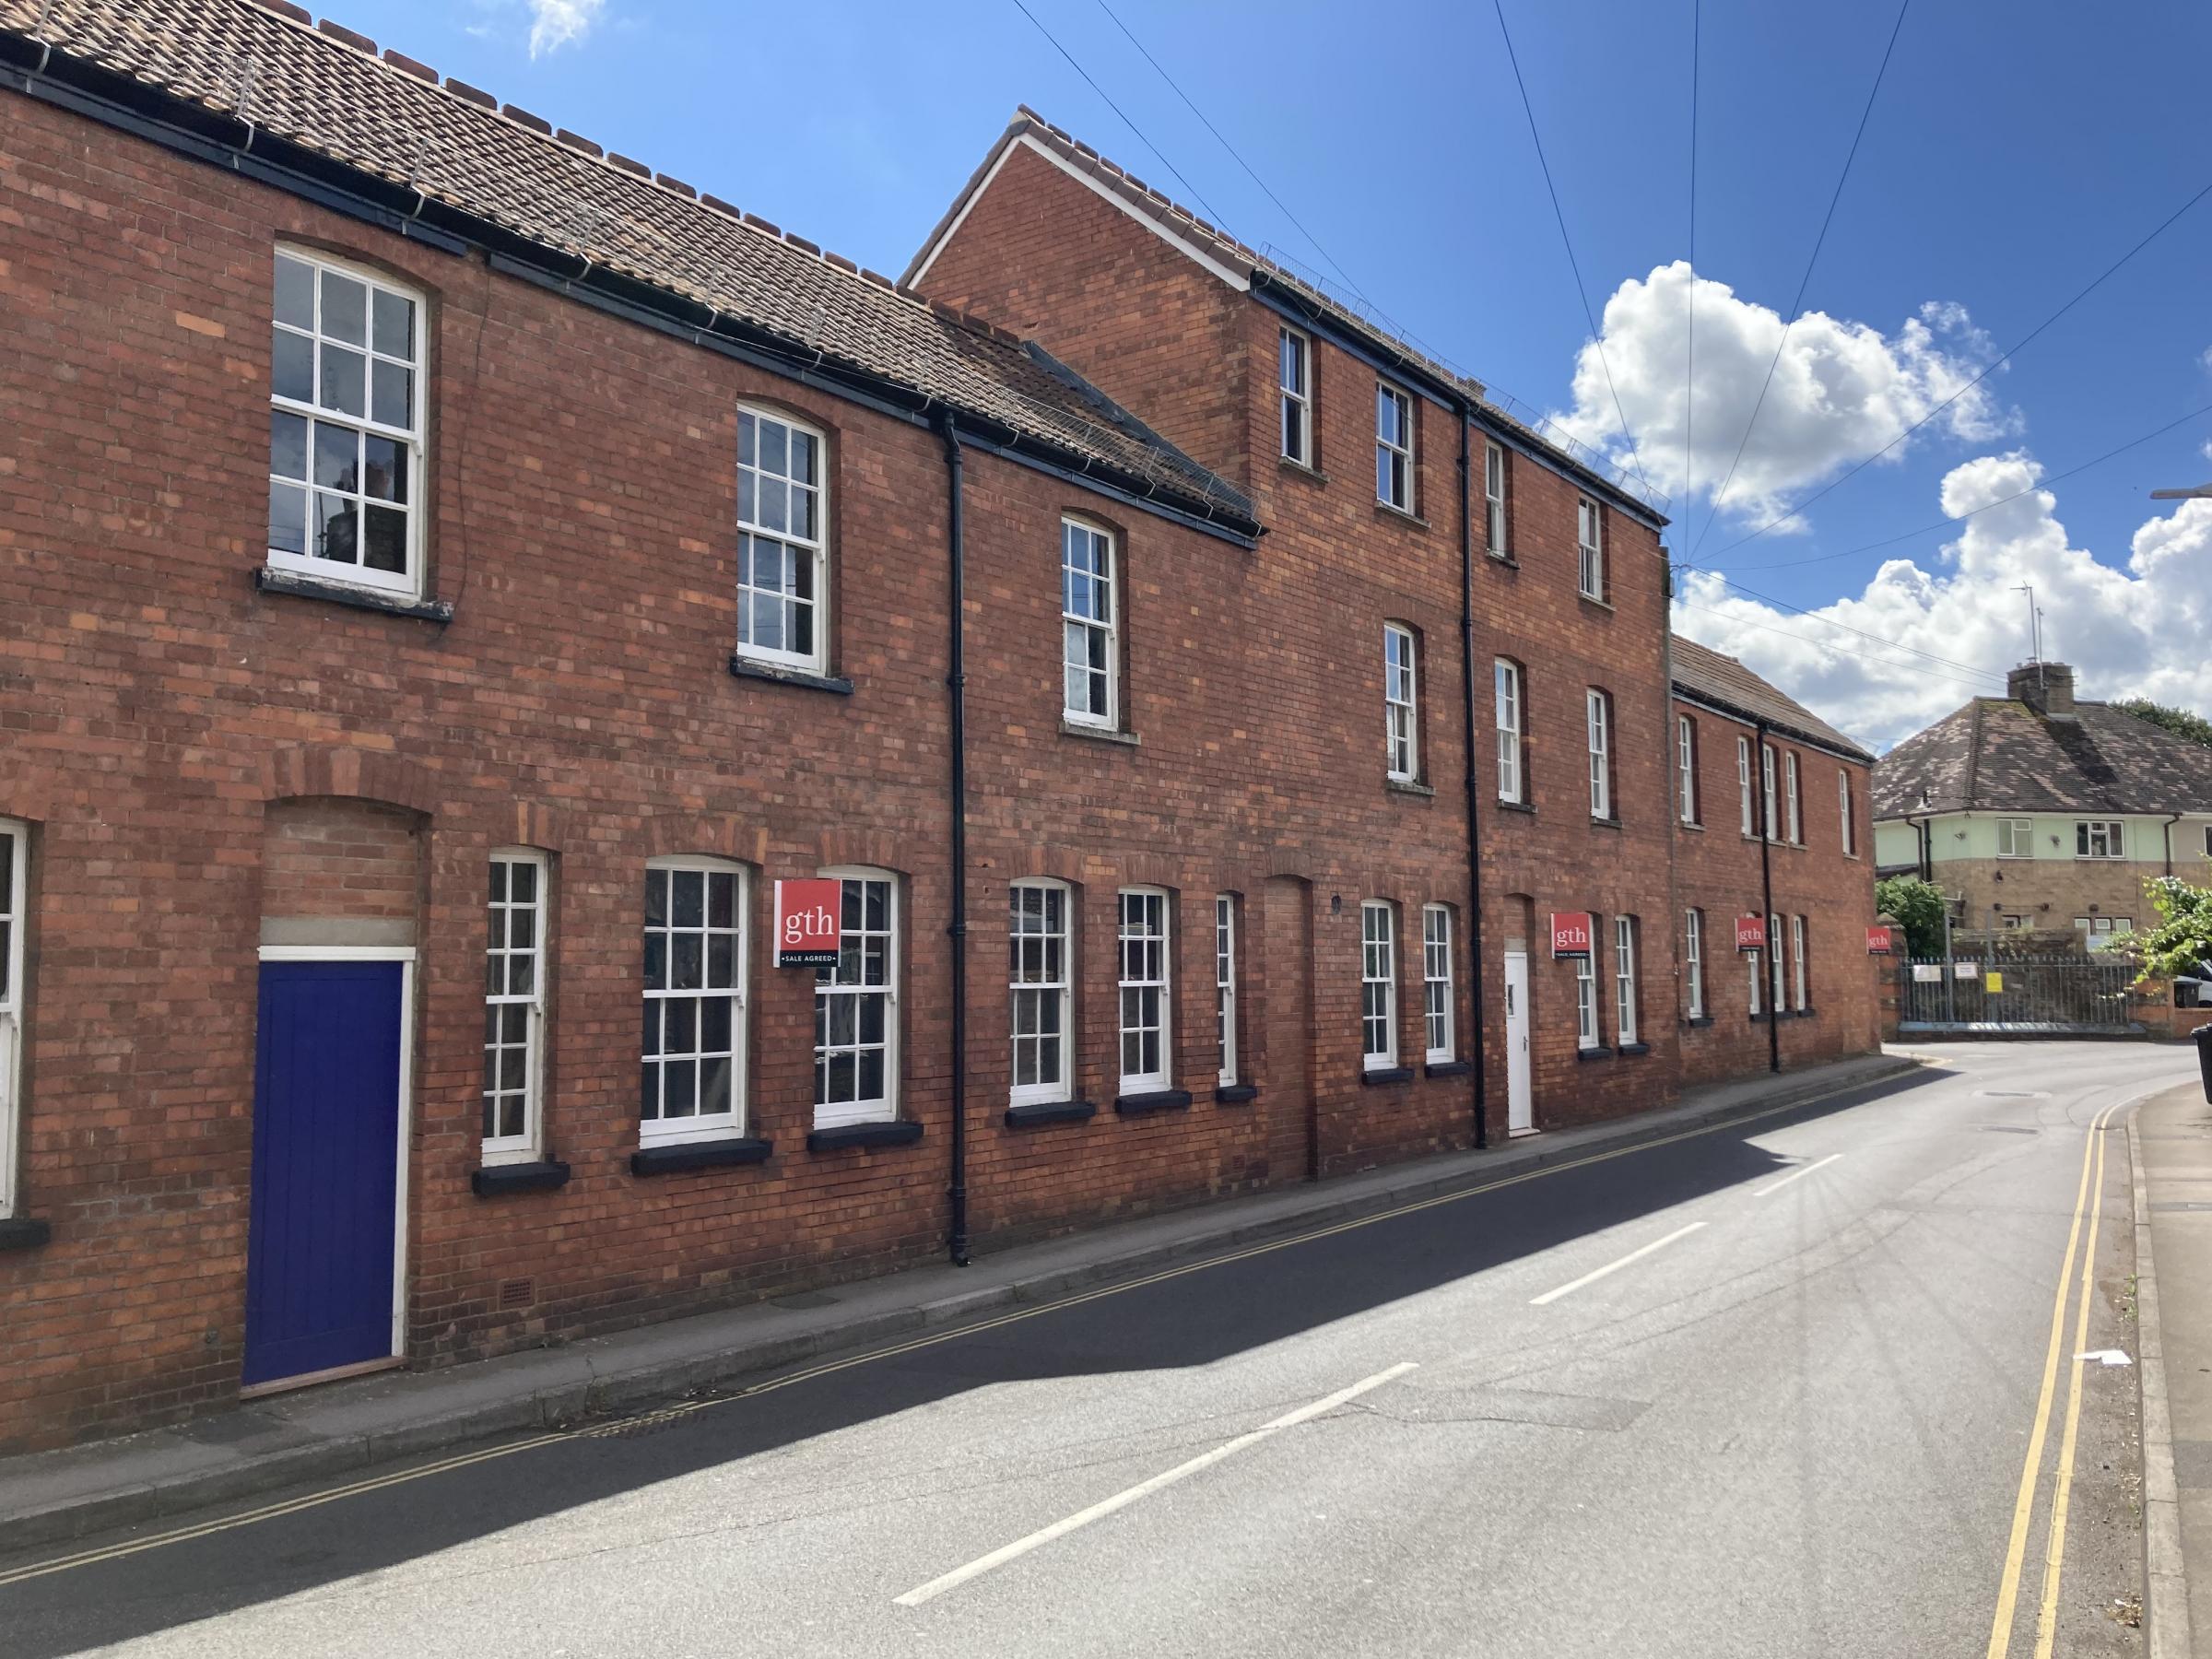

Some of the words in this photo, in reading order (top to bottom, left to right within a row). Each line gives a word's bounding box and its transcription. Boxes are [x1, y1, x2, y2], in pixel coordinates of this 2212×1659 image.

[785, 905, 834, 944] gth
[1557, 926, 1586, 947] gth
[1739, 927, 1762, 943] gth
[1869, 935, 1888, 947] gth
